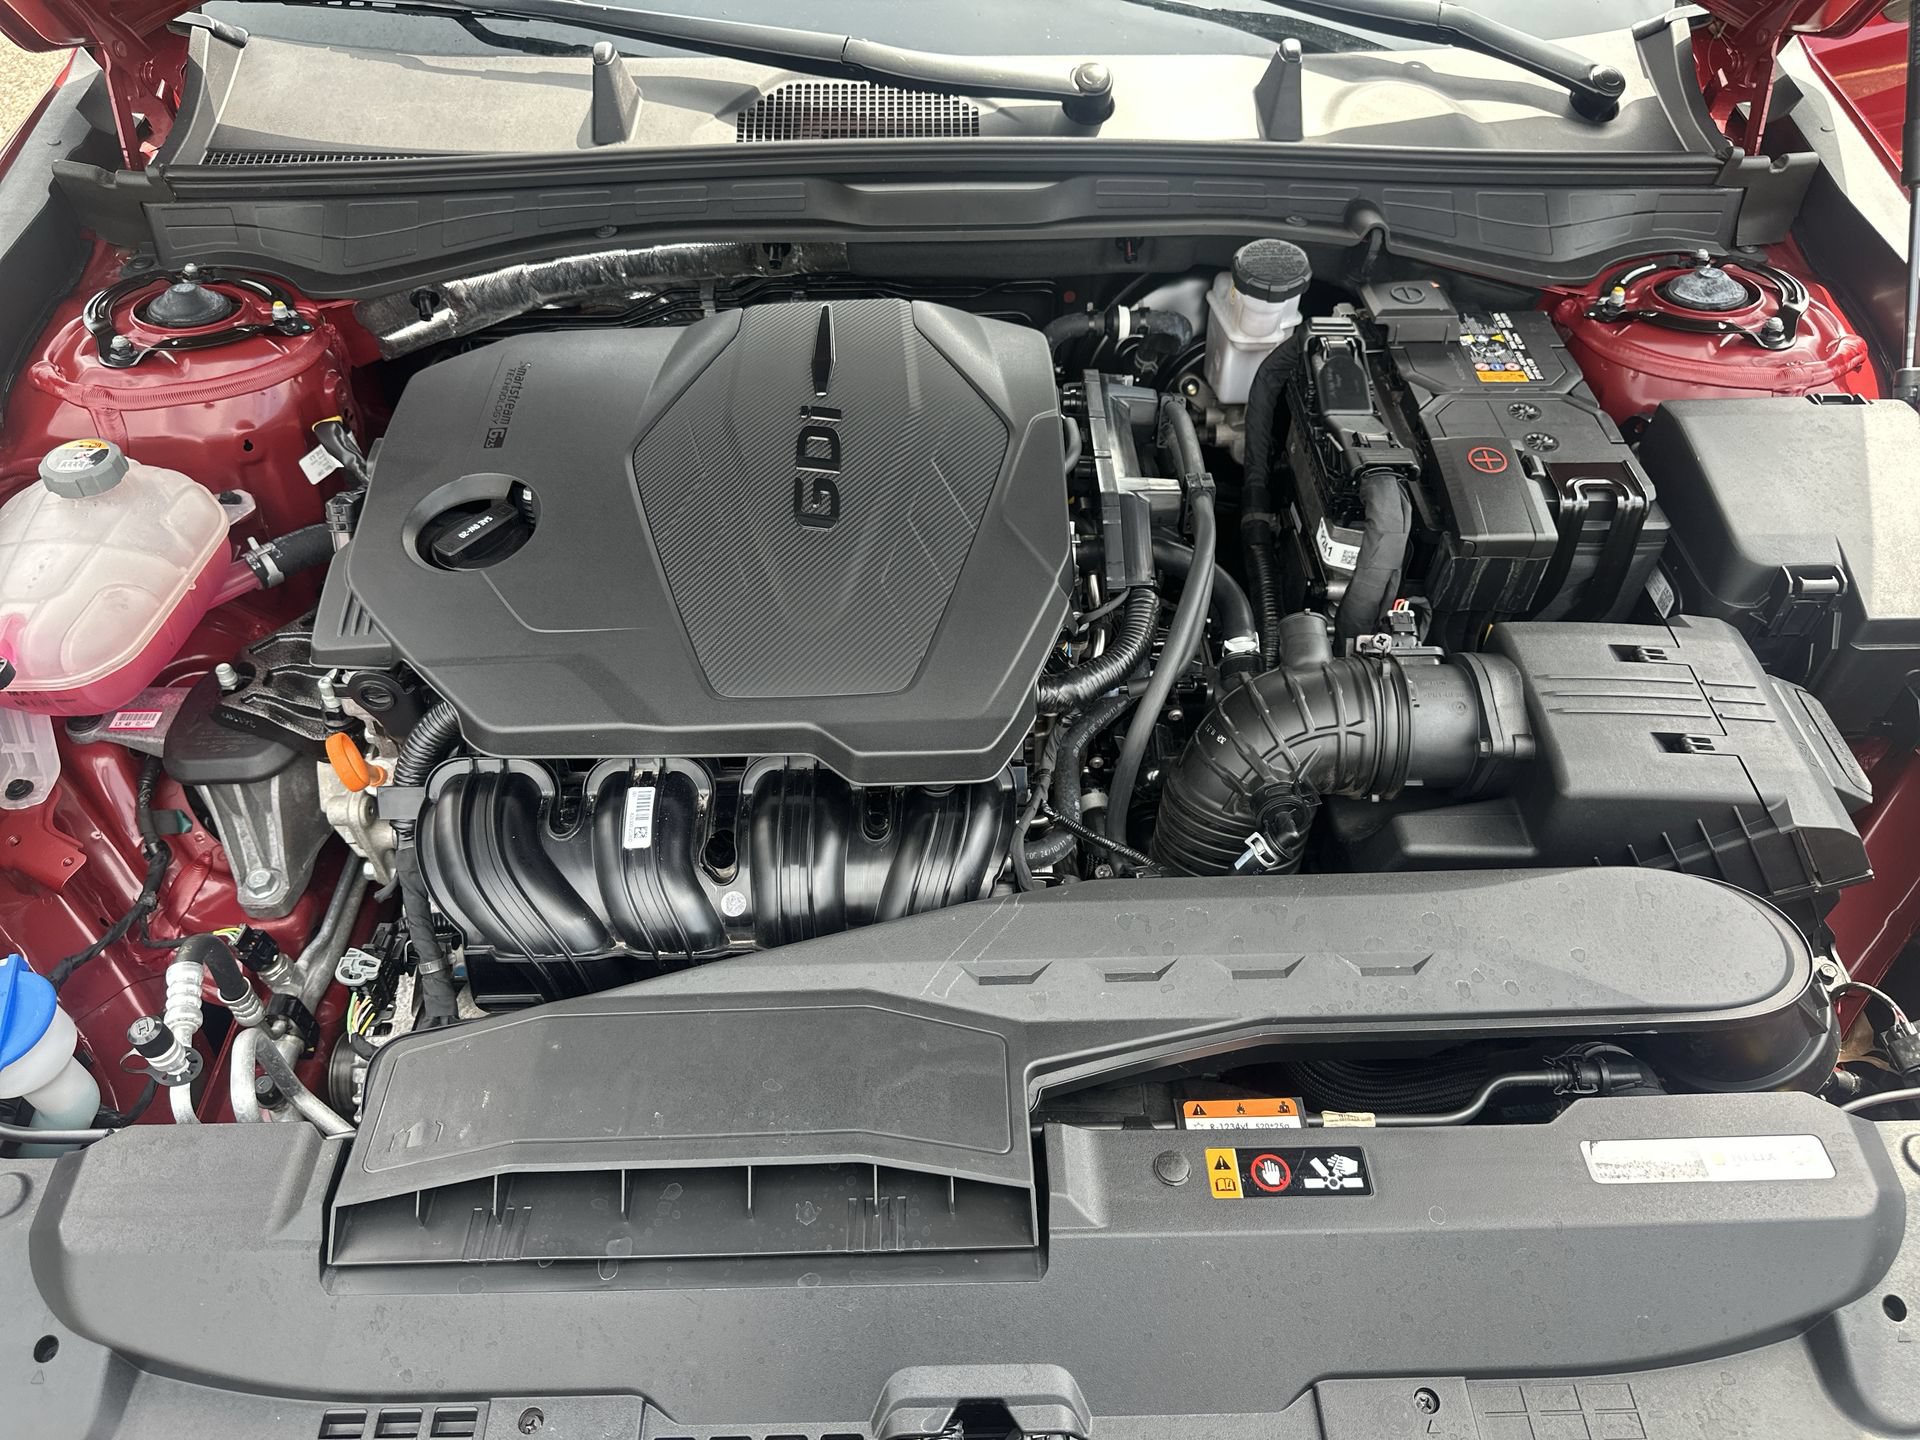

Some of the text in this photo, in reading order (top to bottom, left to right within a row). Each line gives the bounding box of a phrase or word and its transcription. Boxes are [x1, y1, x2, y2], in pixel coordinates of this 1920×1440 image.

[489, 367, 517, 425] TECHNOLOGY
[499, 361, 532, 425] Smartstream
[485, 428, 506, 448] G25
